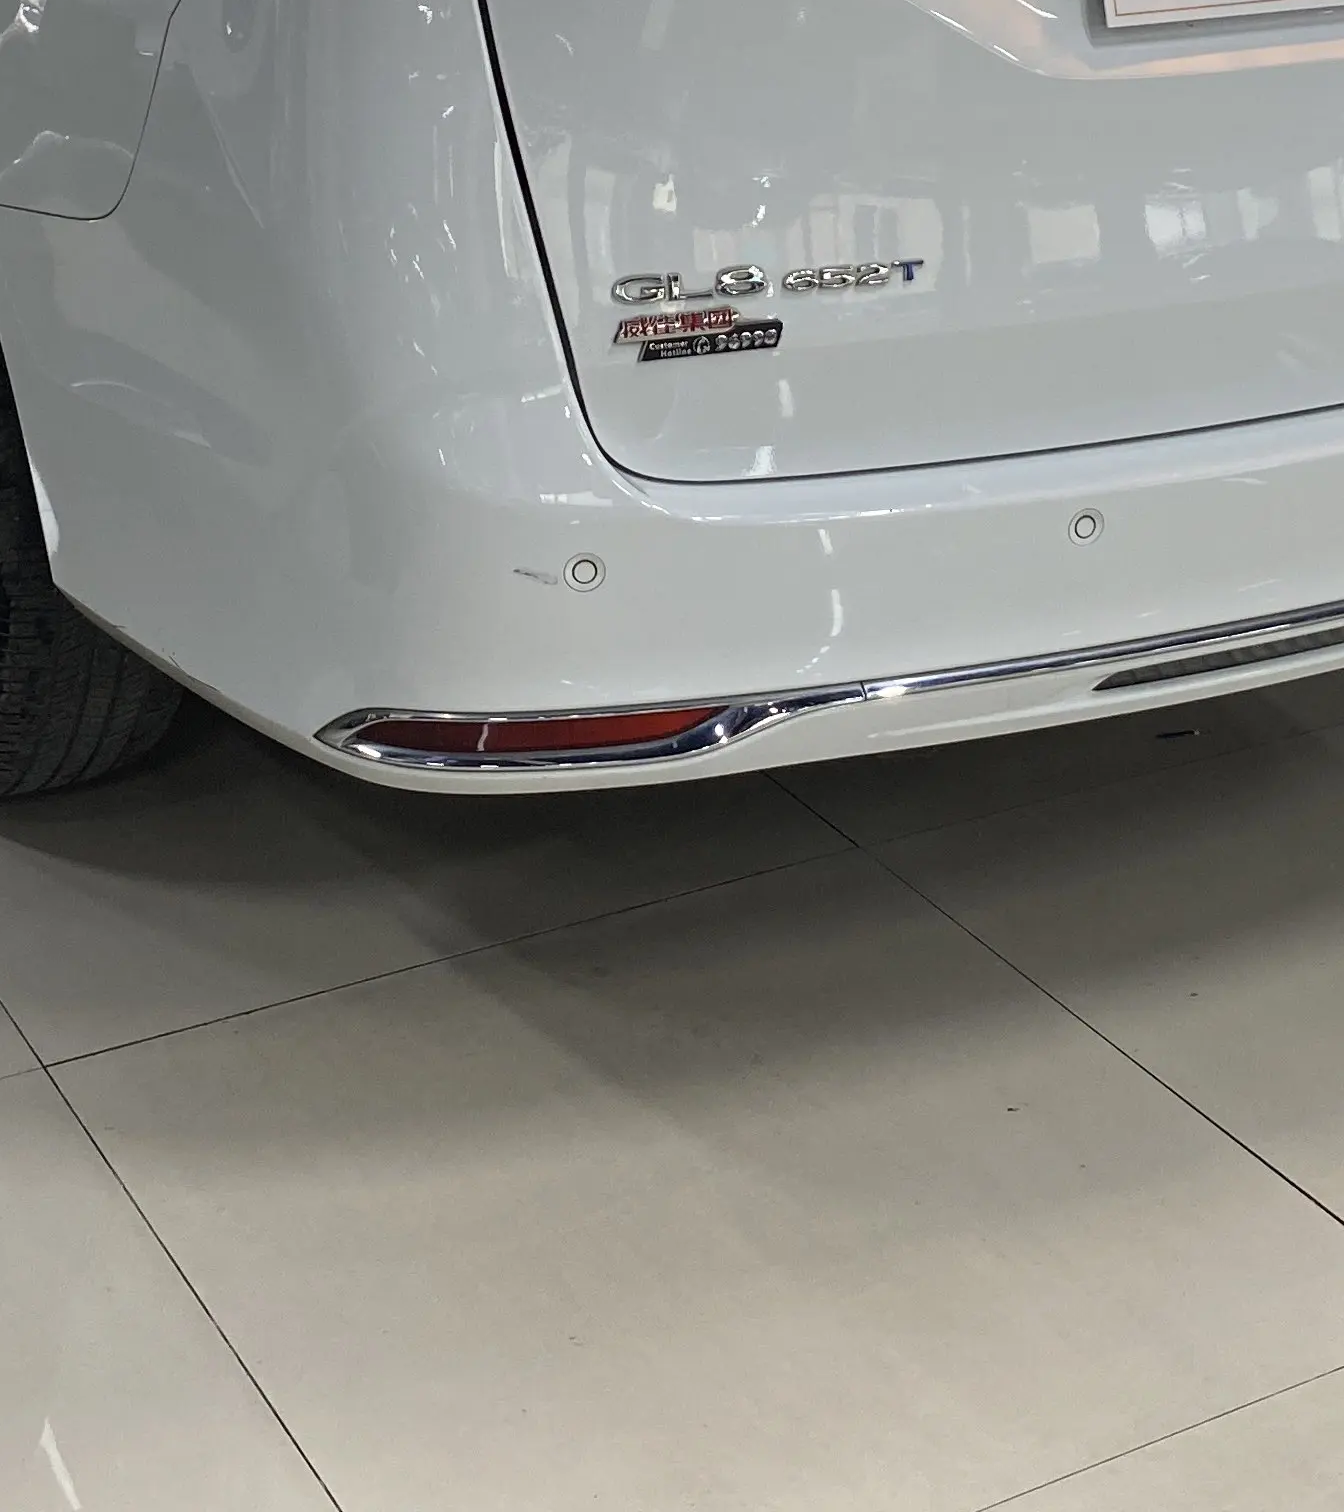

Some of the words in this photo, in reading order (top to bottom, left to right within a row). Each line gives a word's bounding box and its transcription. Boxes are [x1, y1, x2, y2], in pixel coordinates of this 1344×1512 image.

[611, 264, 767, 305] GL8
[782, 259, 924, 291] 652T
[649, 339, 690, 351] Customer
[660, 347, 693, 358] Hotline
